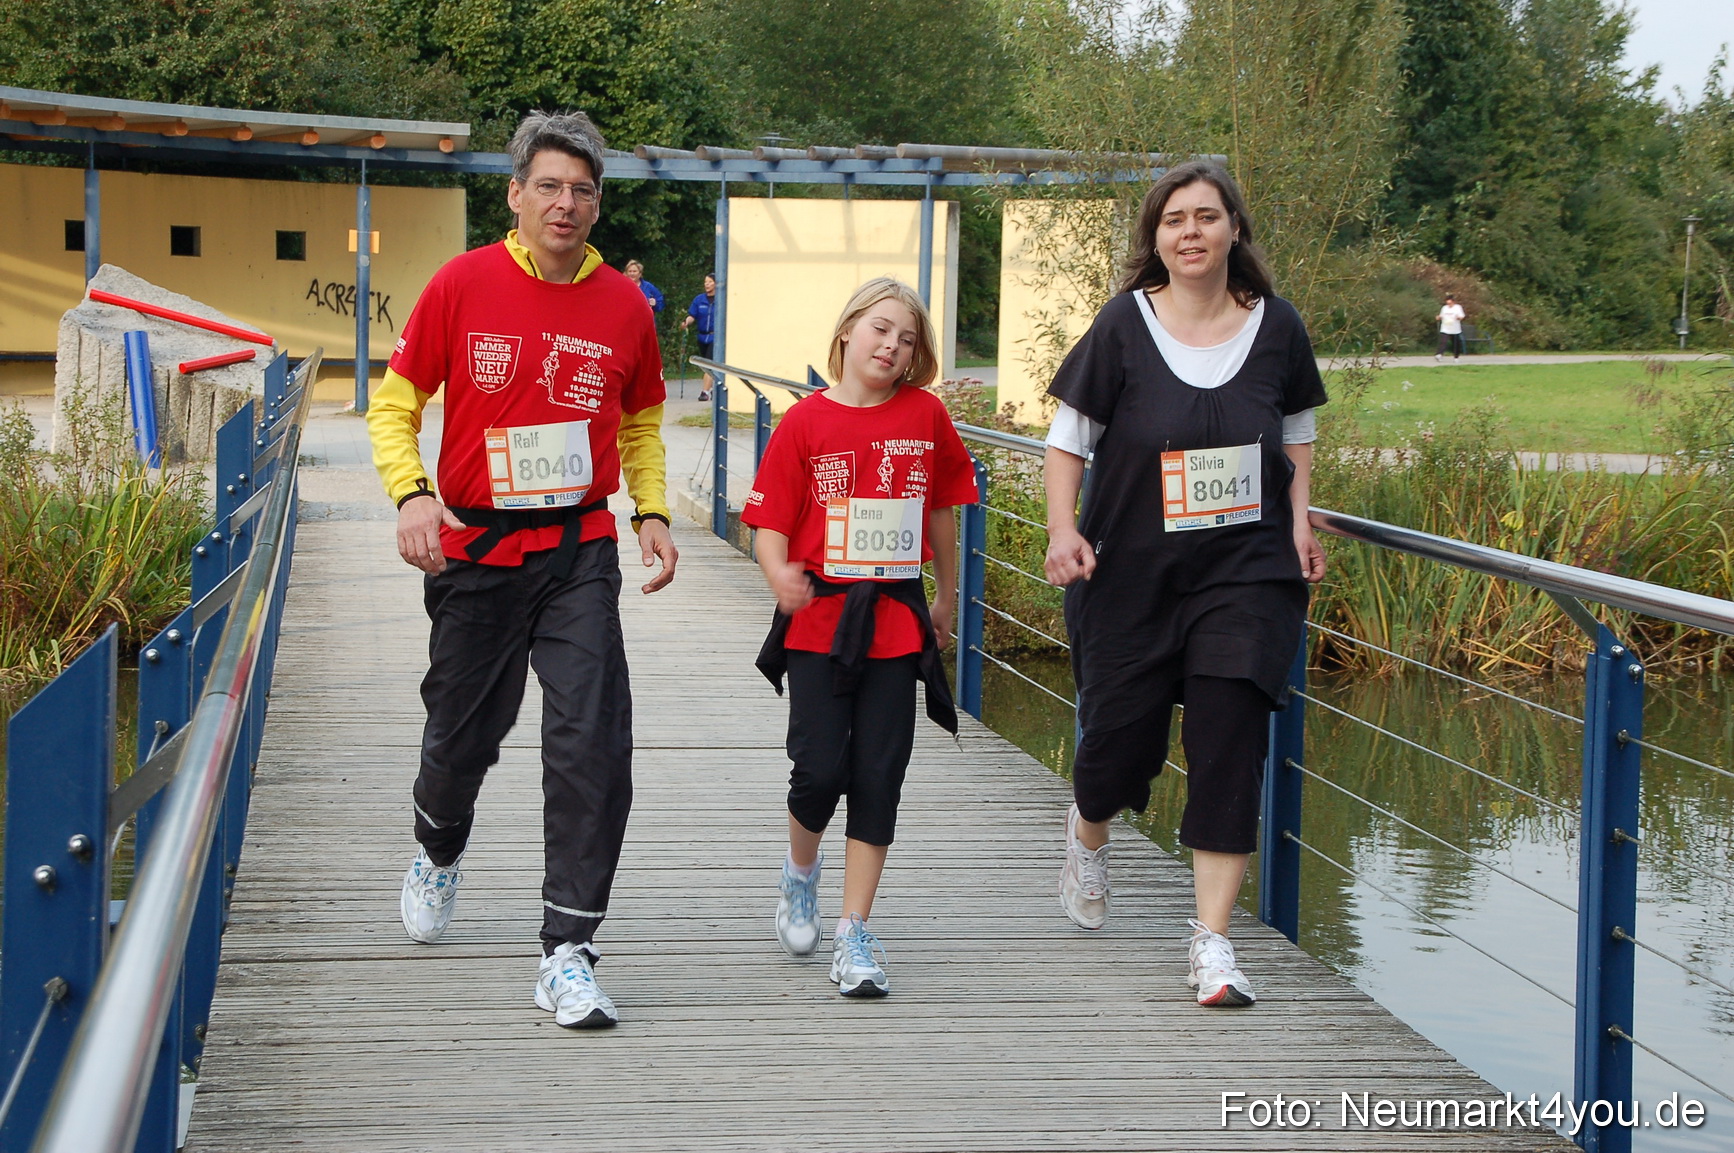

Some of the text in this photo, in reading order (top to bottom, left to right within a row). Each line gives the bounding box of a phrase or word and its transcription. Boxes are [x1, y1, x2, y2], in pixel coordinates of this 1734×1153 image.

[474, 341, 511, 352] IMMER
[542, 332, 612, 356] 11. NEUMARKTER
[553, 342, 602, 360] STADTLAUF
[473, 351, 512, 362] WIEDER
[475, 360, 508, 374] NEU
[476, 374, 506, 384] MARKT
[513, 431, 539, 449] Ralf
[871, 439, 934, 450] 11. NEUMARKTER
[884, 448, 924, 456] STADTLAUF
[518, 453, 584, 481] 8040
[814, 460, 848, 472] IMMER
[1190, 456, 1224, 471] Silvia
[814, 468, 850, 480] WIEDER
[817, 479, 848, 493] NEU
[1193, 475, 1250, 502] 8041
[819, 490, 848, 502] MARKT
[854, 504, 882, 520] Lena
[1226, 509, 1259, 519] PFLEIDERER
[854, 530, 914, 551] 8039
